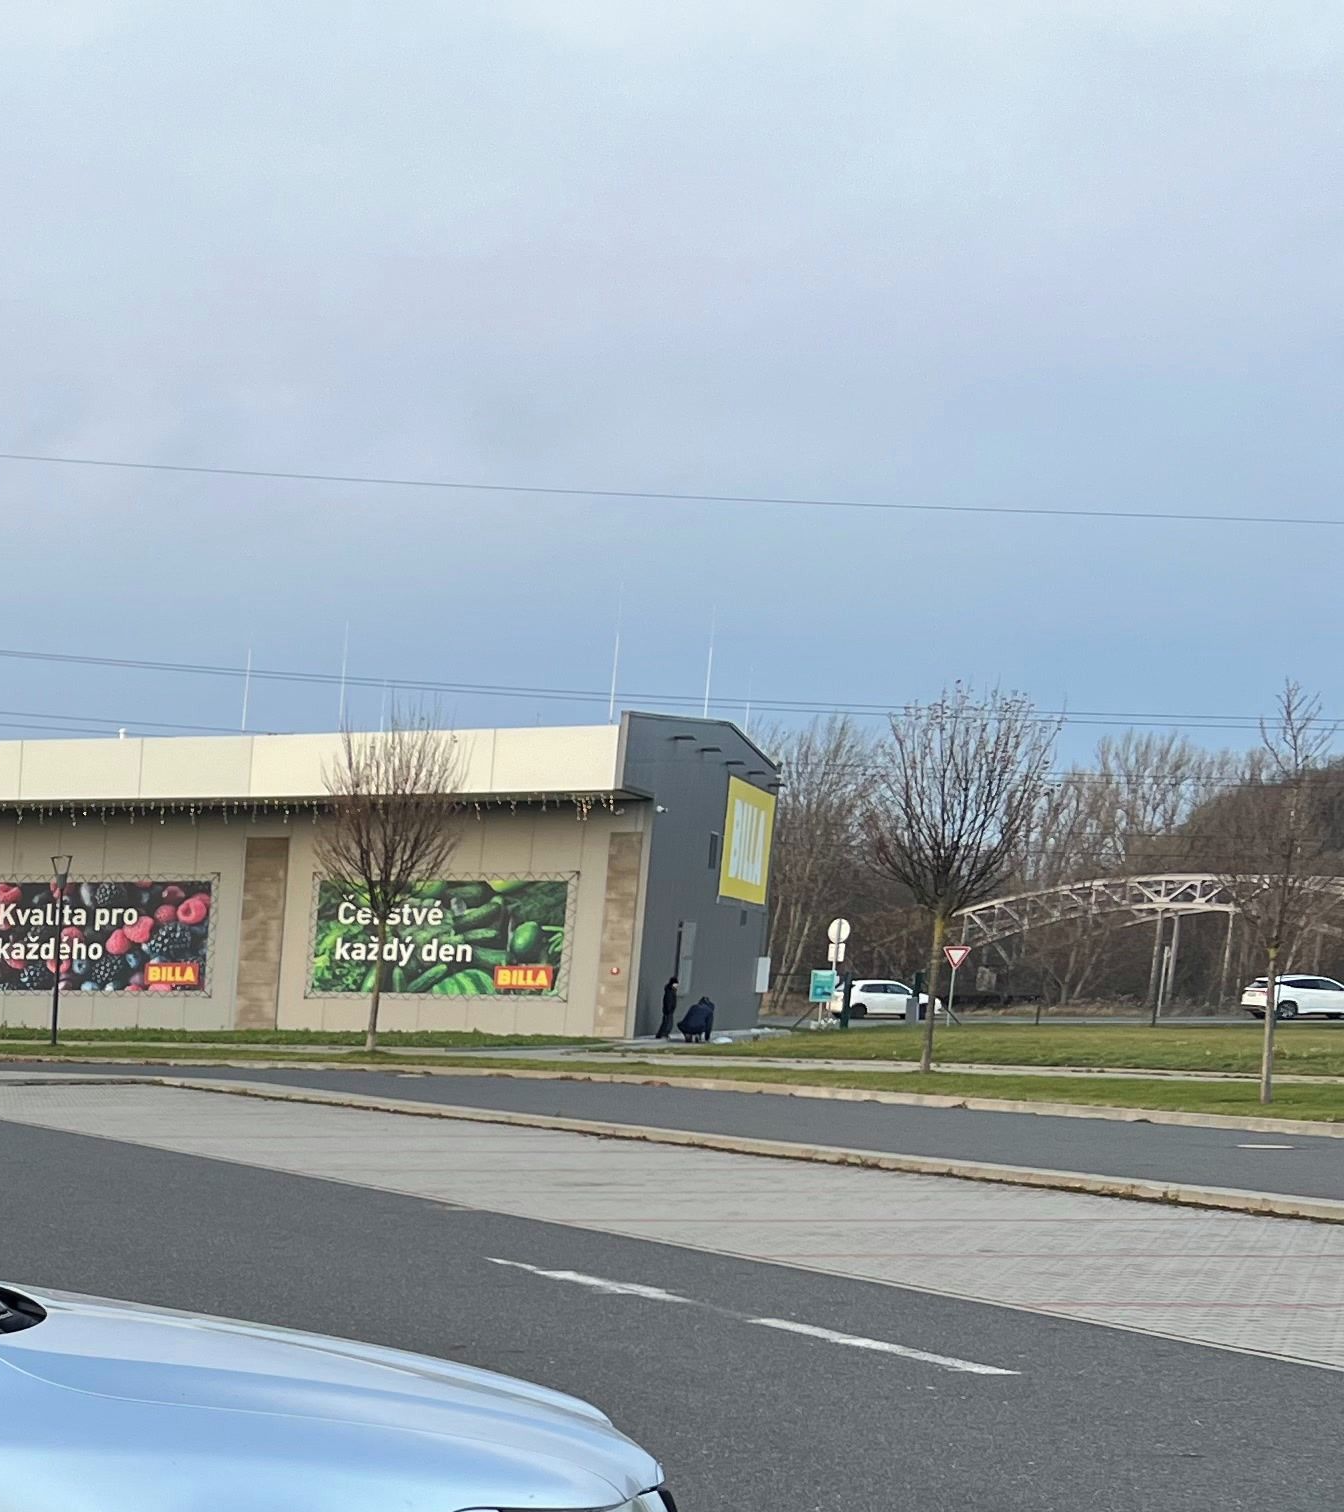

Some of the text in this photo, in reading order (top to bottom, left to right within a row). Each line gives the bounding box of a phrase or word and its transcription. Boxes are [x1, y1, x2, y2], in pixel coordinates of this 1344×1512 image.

[728, 798, 765, 886] BILLA
[95, 907, 139, 932] pro
[335, 936, 473, 967] každý den
[147, 965, 196, 982] BILLA
[496, 969, 549, 986] BILLA
